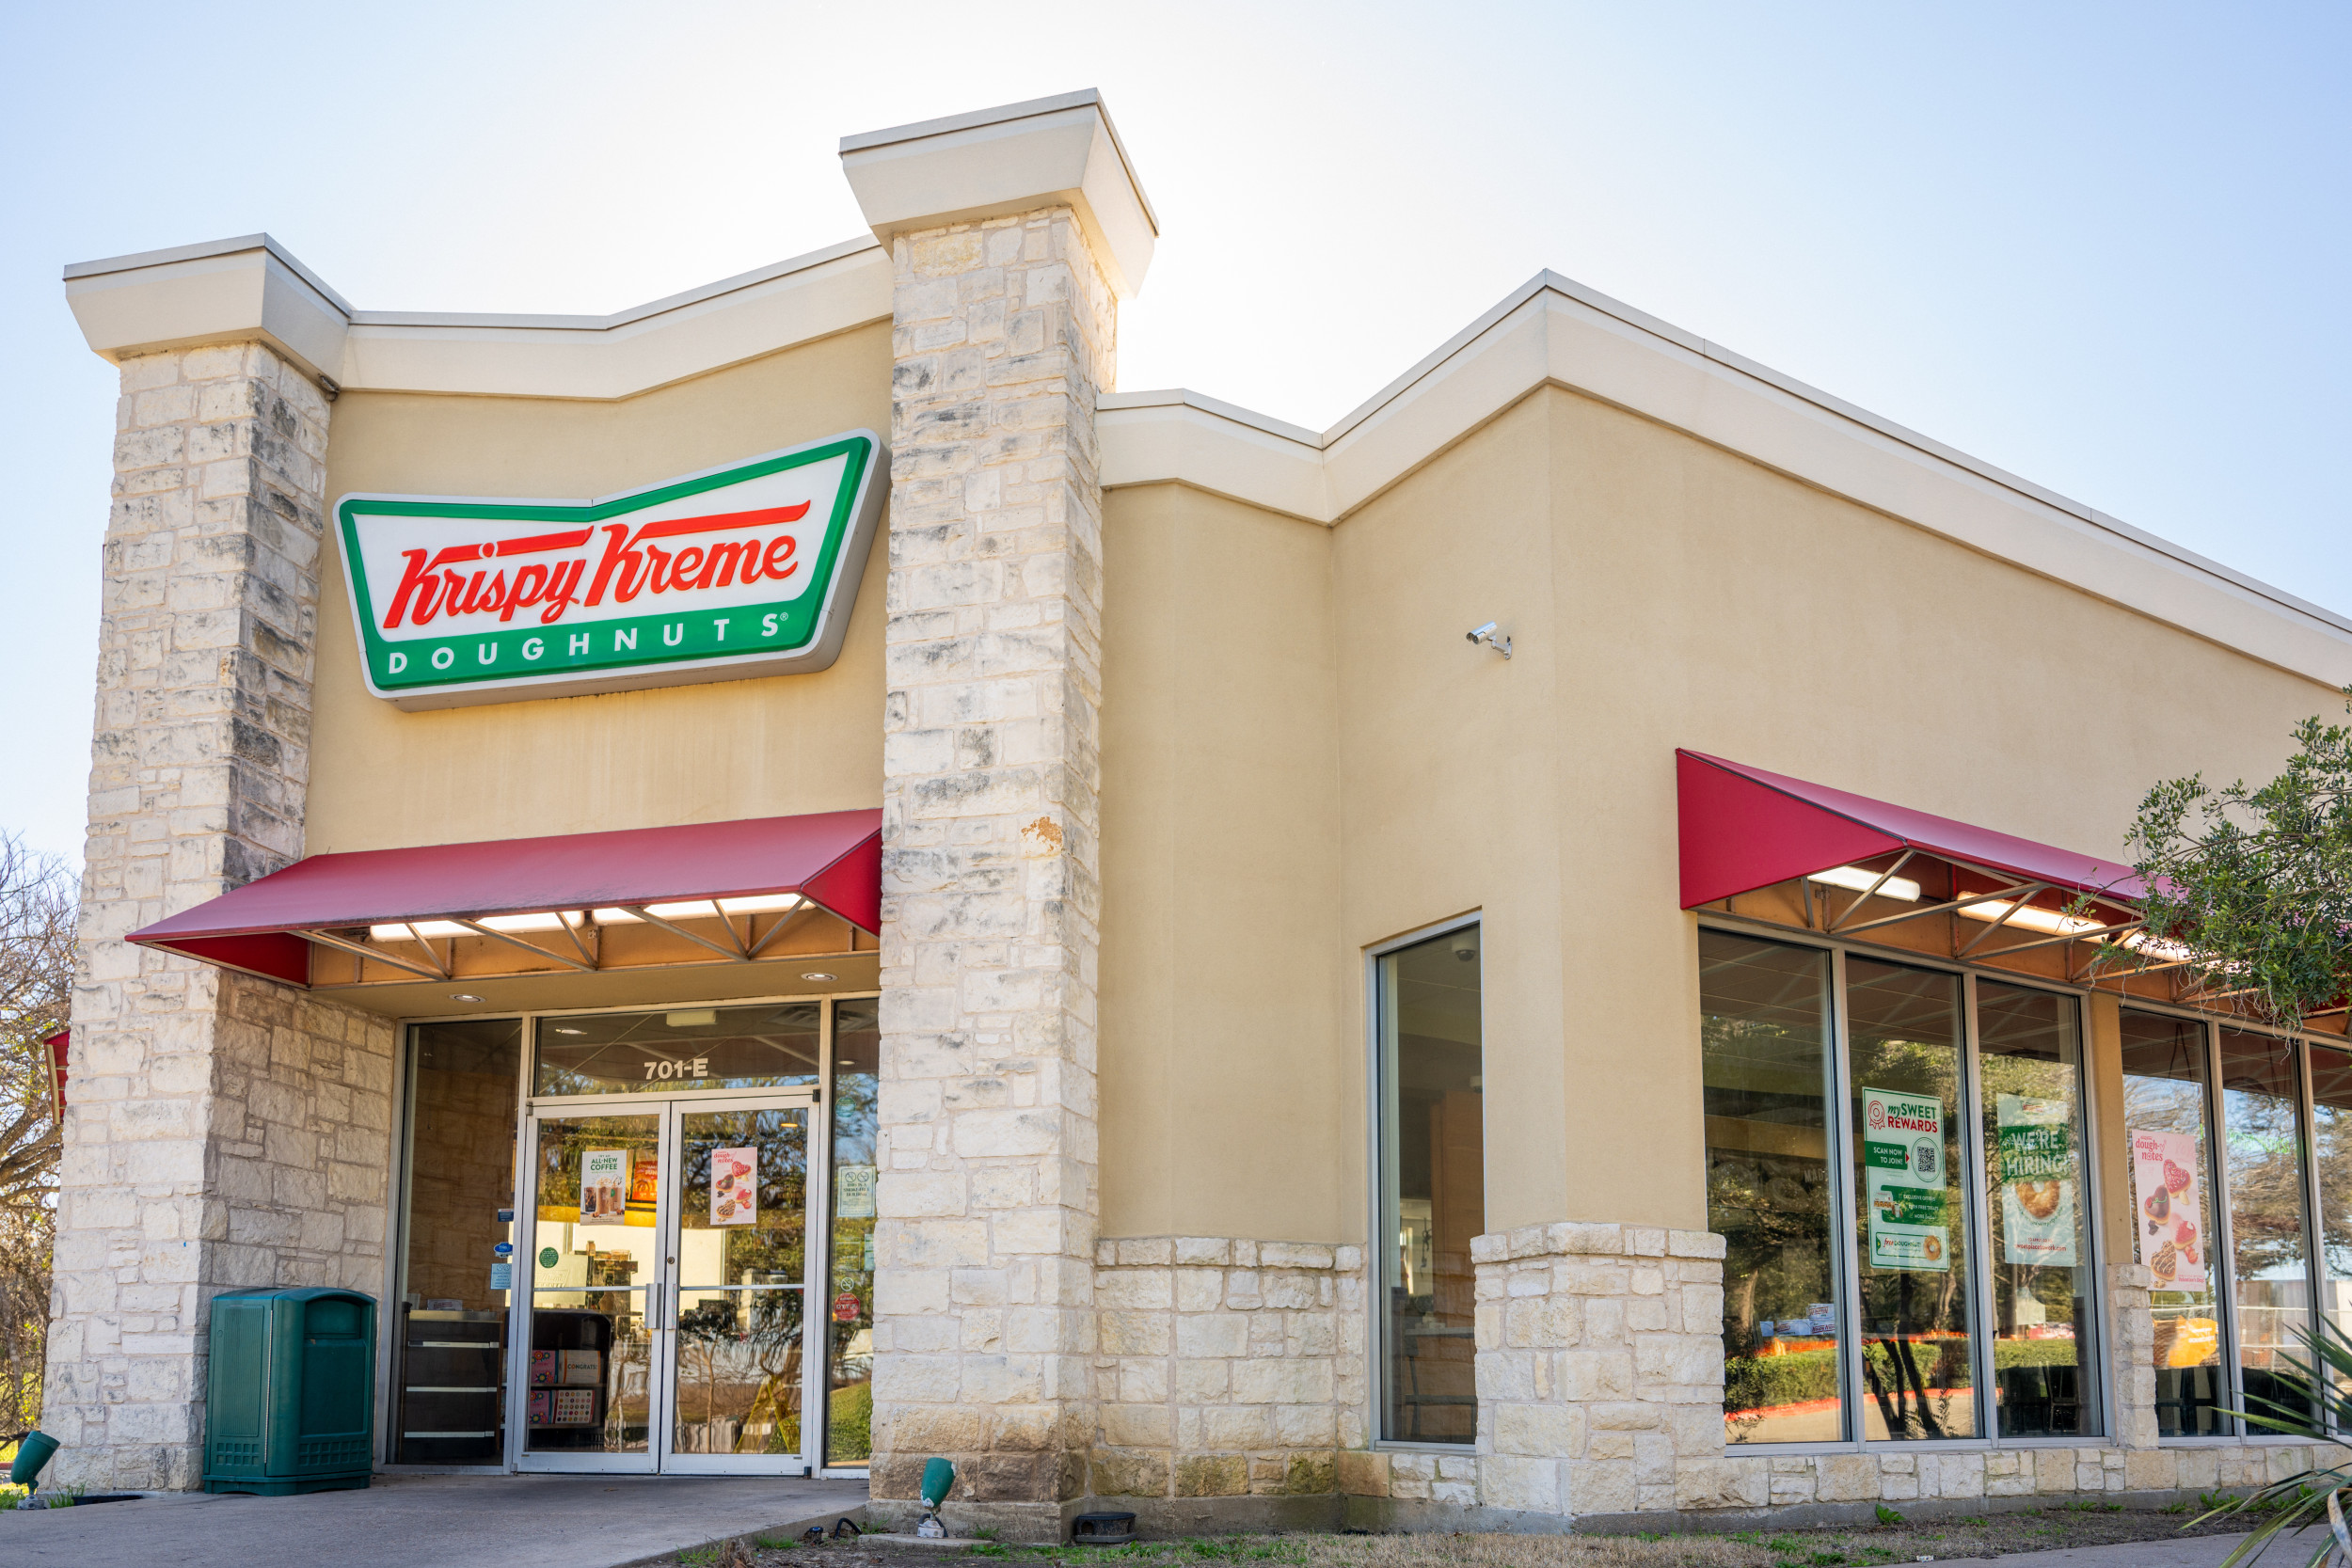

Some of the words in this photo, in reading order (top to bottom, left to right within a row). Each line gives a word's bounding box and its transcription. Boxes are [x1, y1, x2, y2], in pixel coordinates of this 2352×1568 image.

[383, 525, 594, 628] Krispy
[583, 499, 811, 607] Kreme
[644, 1057, 708, 1080] 701-E
[1887, 1116, 1938, 1133] REWARDS
[2011, 1129, 2059, 1150] WE'RE
[1873, 1147, 1888, 1155] SCAN
[1888, 1148, 1903, 1156] NOW
[1888, 1157, 1903, 1165] JOIN!
[1883, 1237, 1894, 1248] free
